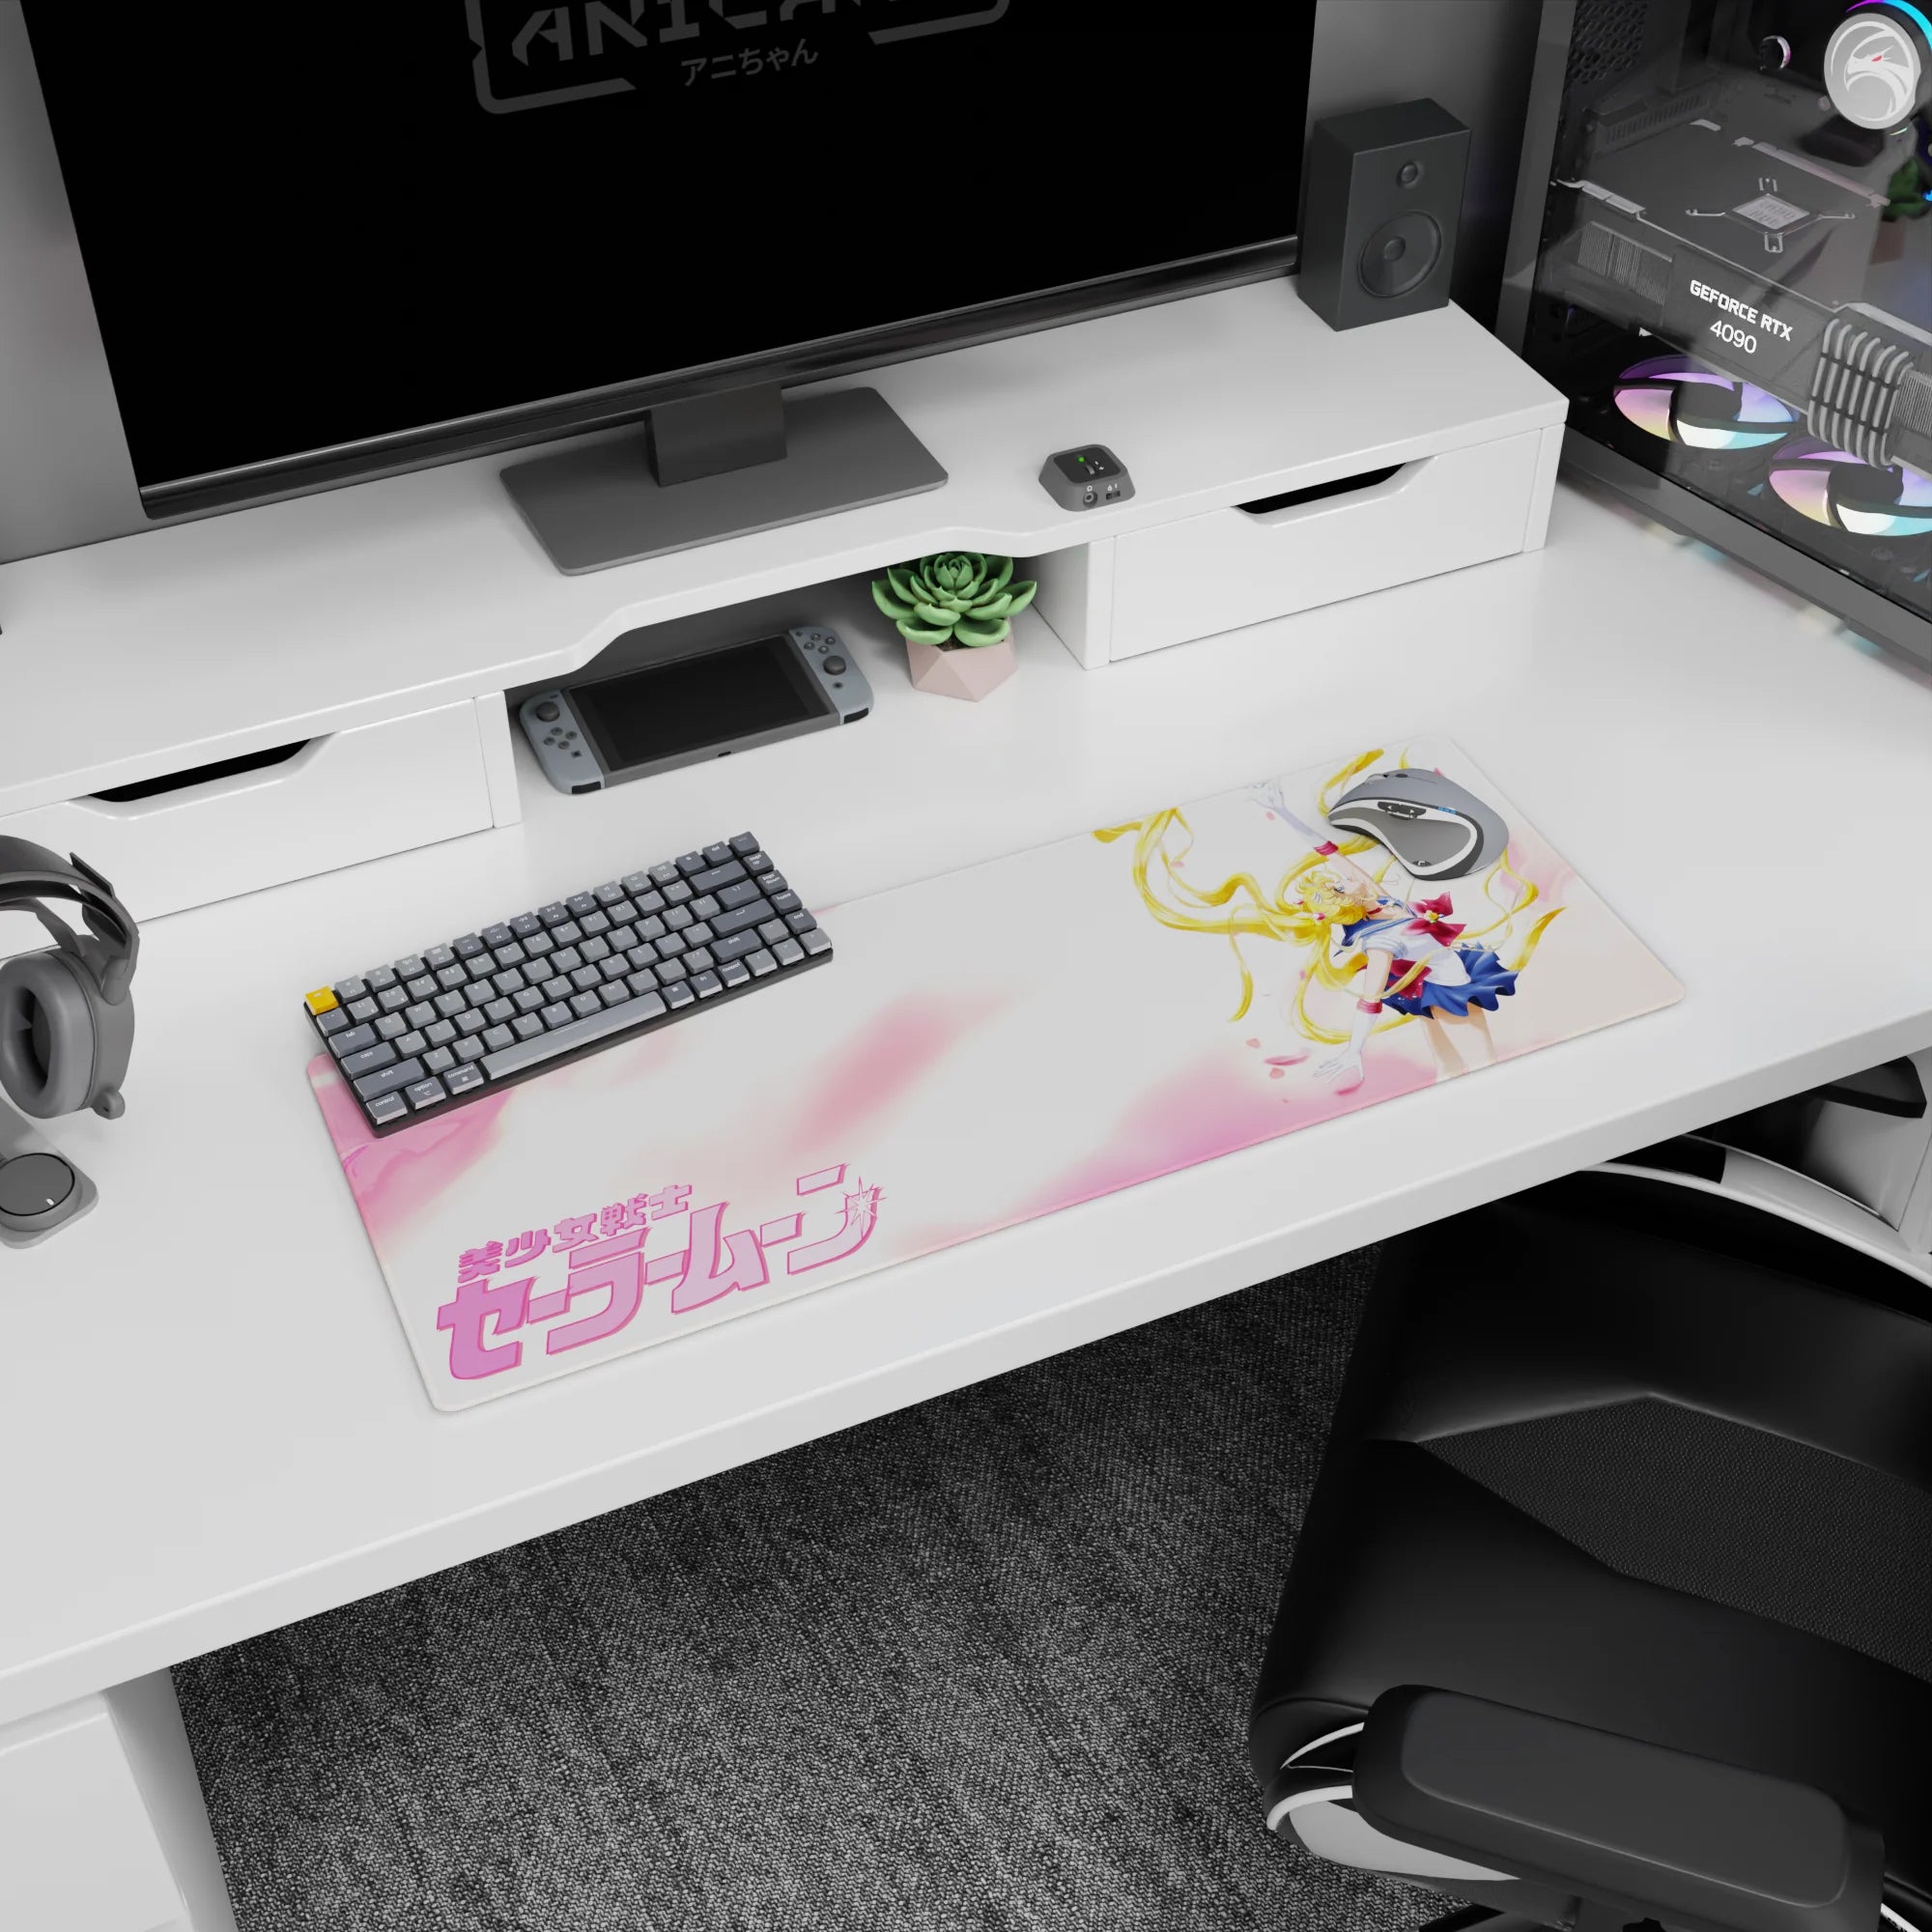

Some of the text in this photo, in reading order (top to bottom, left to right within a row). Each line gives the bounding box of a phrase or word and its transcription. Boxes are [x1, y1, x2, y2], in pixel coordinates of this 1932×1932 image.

[680, 38, 818, 87] アニちゃん
[1690, 279, 1793, 341] GEFORCE RTX
[1710, 320, 1757, 354] 4090
[458, 1183, 693, 1282] 美少女戦士
[437, 1163, 884, 1380] セーラームーン
